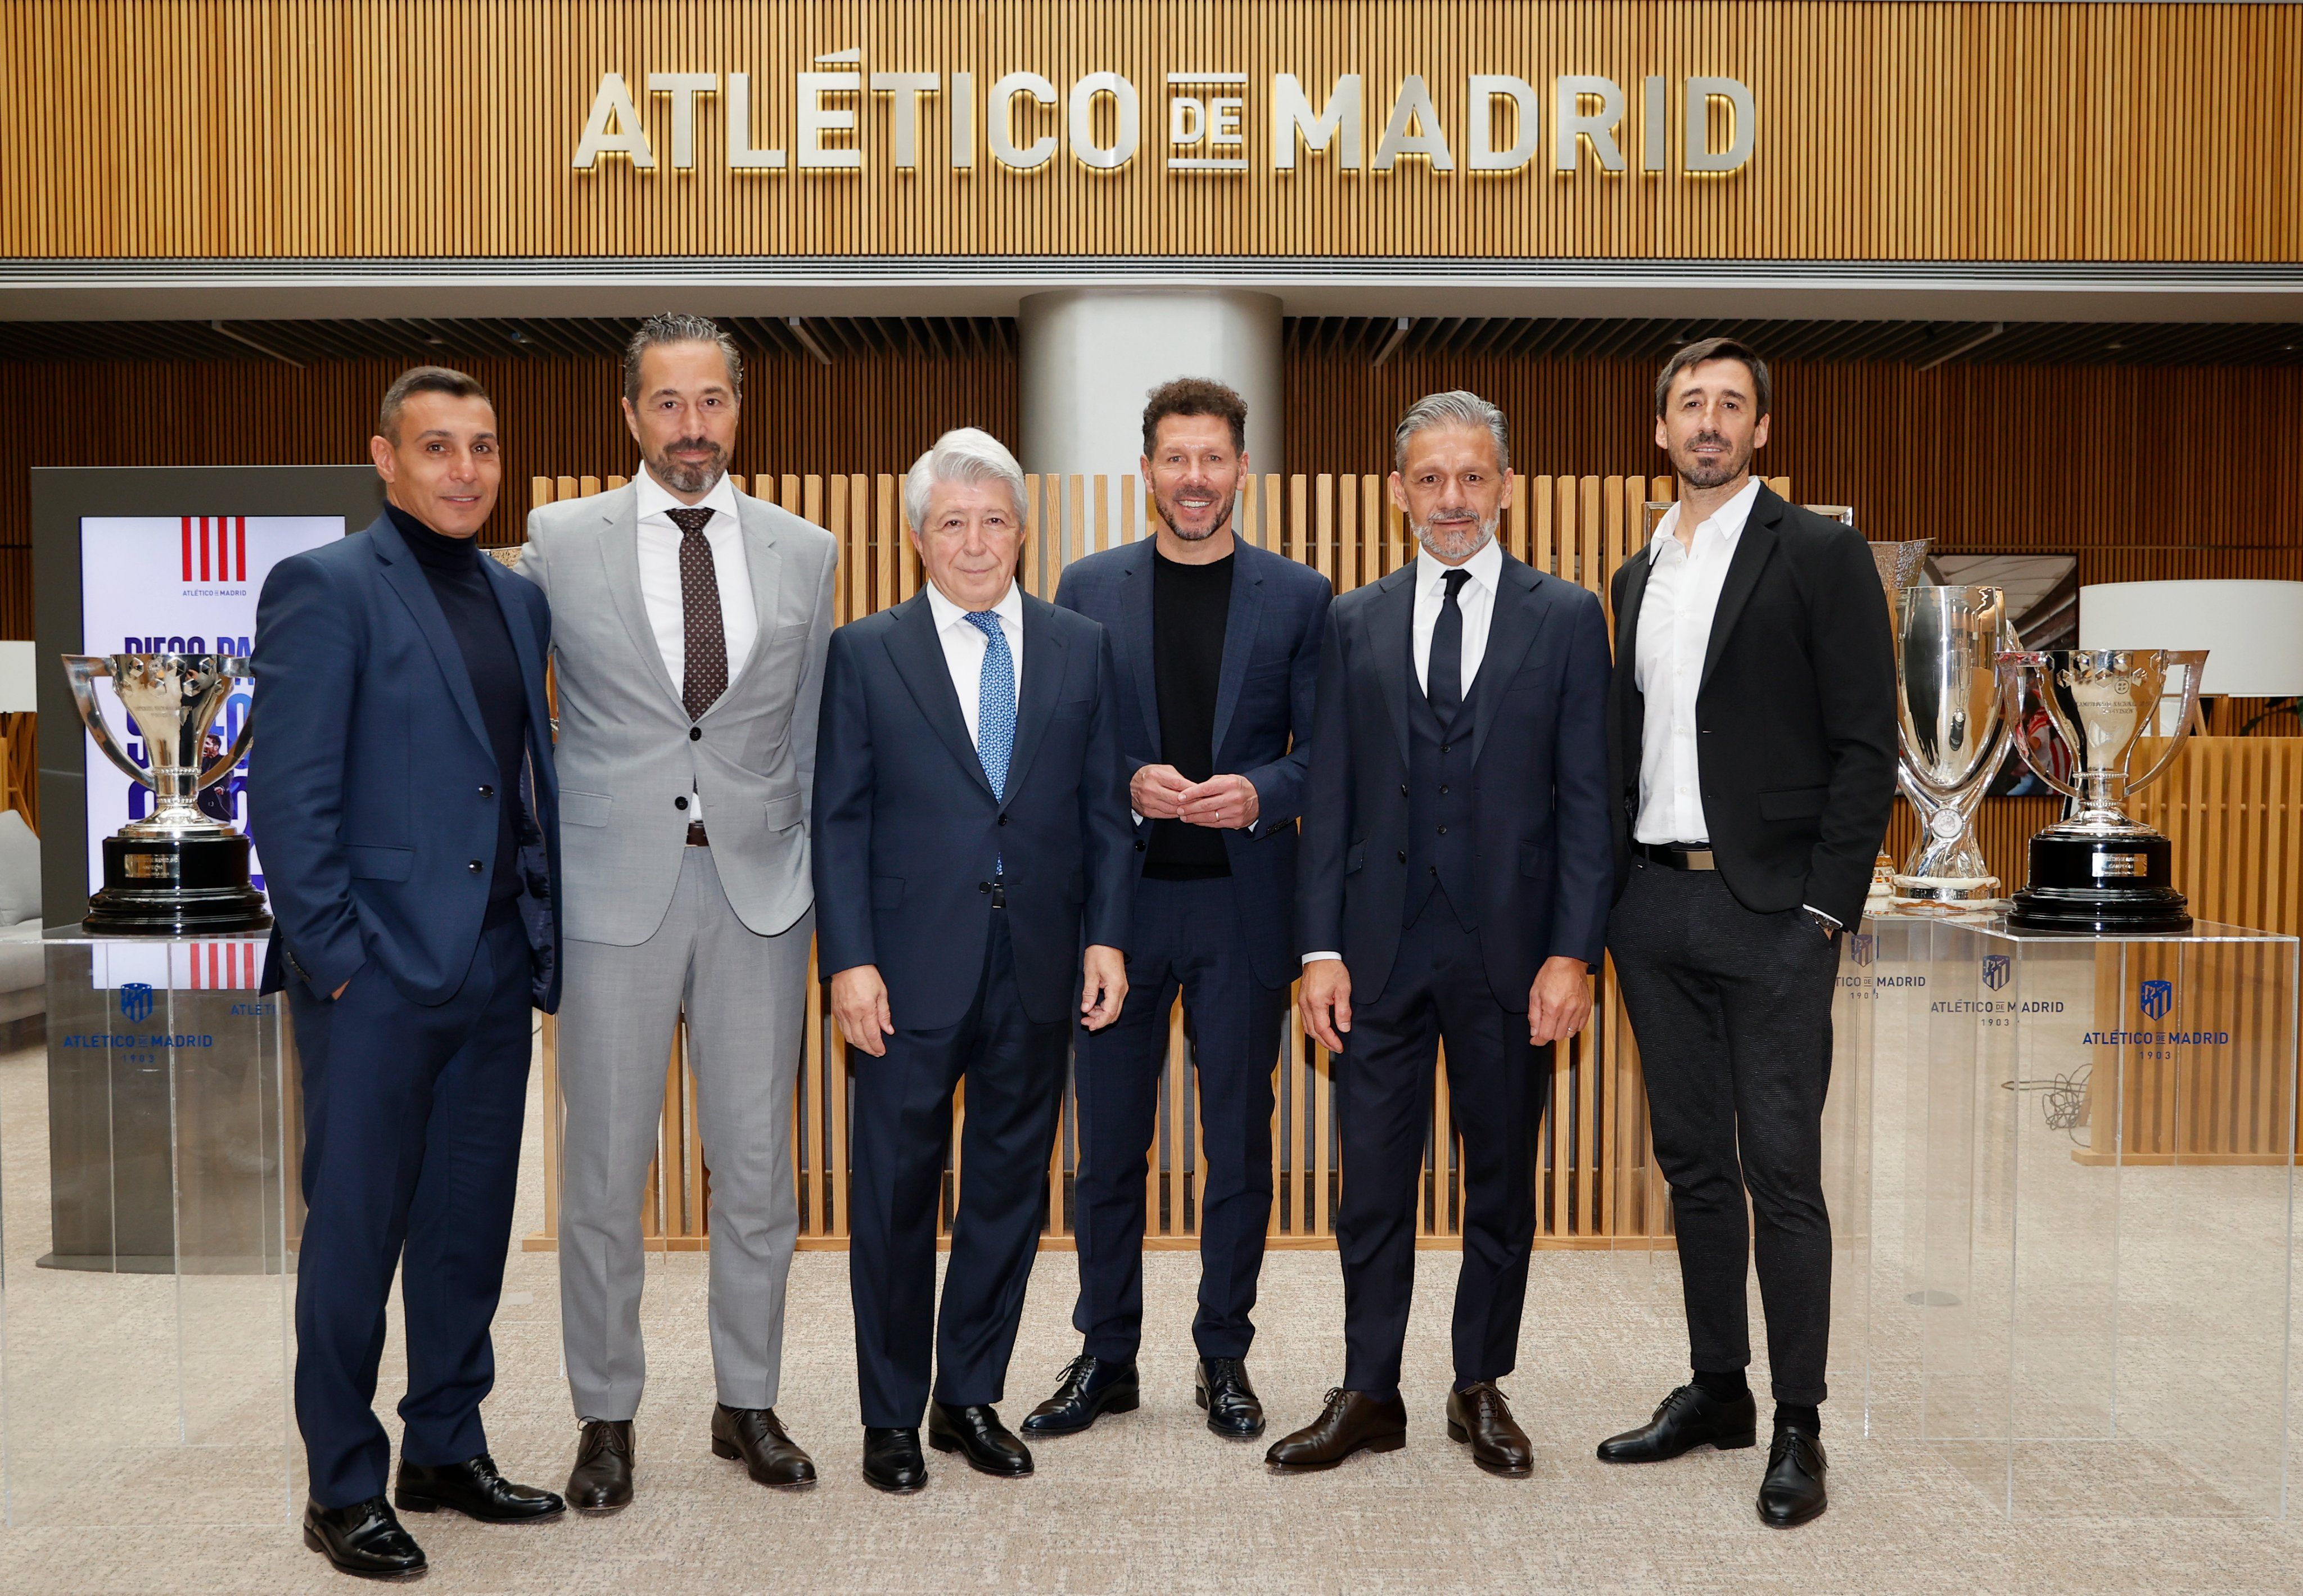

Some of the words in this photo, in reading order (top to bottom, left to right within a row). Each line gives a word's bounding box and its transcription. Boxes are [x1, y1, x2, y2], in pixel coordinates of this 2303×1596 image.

[571, 47, 1140, 170] ATLÉTICO
[1171, 96, 1243, 145] DE
[1274, 73, 1756, 172] MADRID
[1836, 976, 1861, 987] TICO
[1877, 976, 1926, 987] MADRID
[1931, 999, 1993, 1012] ATLÉTICO
[2007, 1002, 2064, 1012] MADRID
[63, 1032, 135, 1048] ATLÉTICO
[151, 1035, 213, 1048] MADRID
[2082, 1029, 2153, 1045] ATLÉTICO
[2168, 1032, 2229, 1045] MADRID
[122, 1054, 155, 1063] 1903
[2138, 1051, 2171, 1060] 1903
